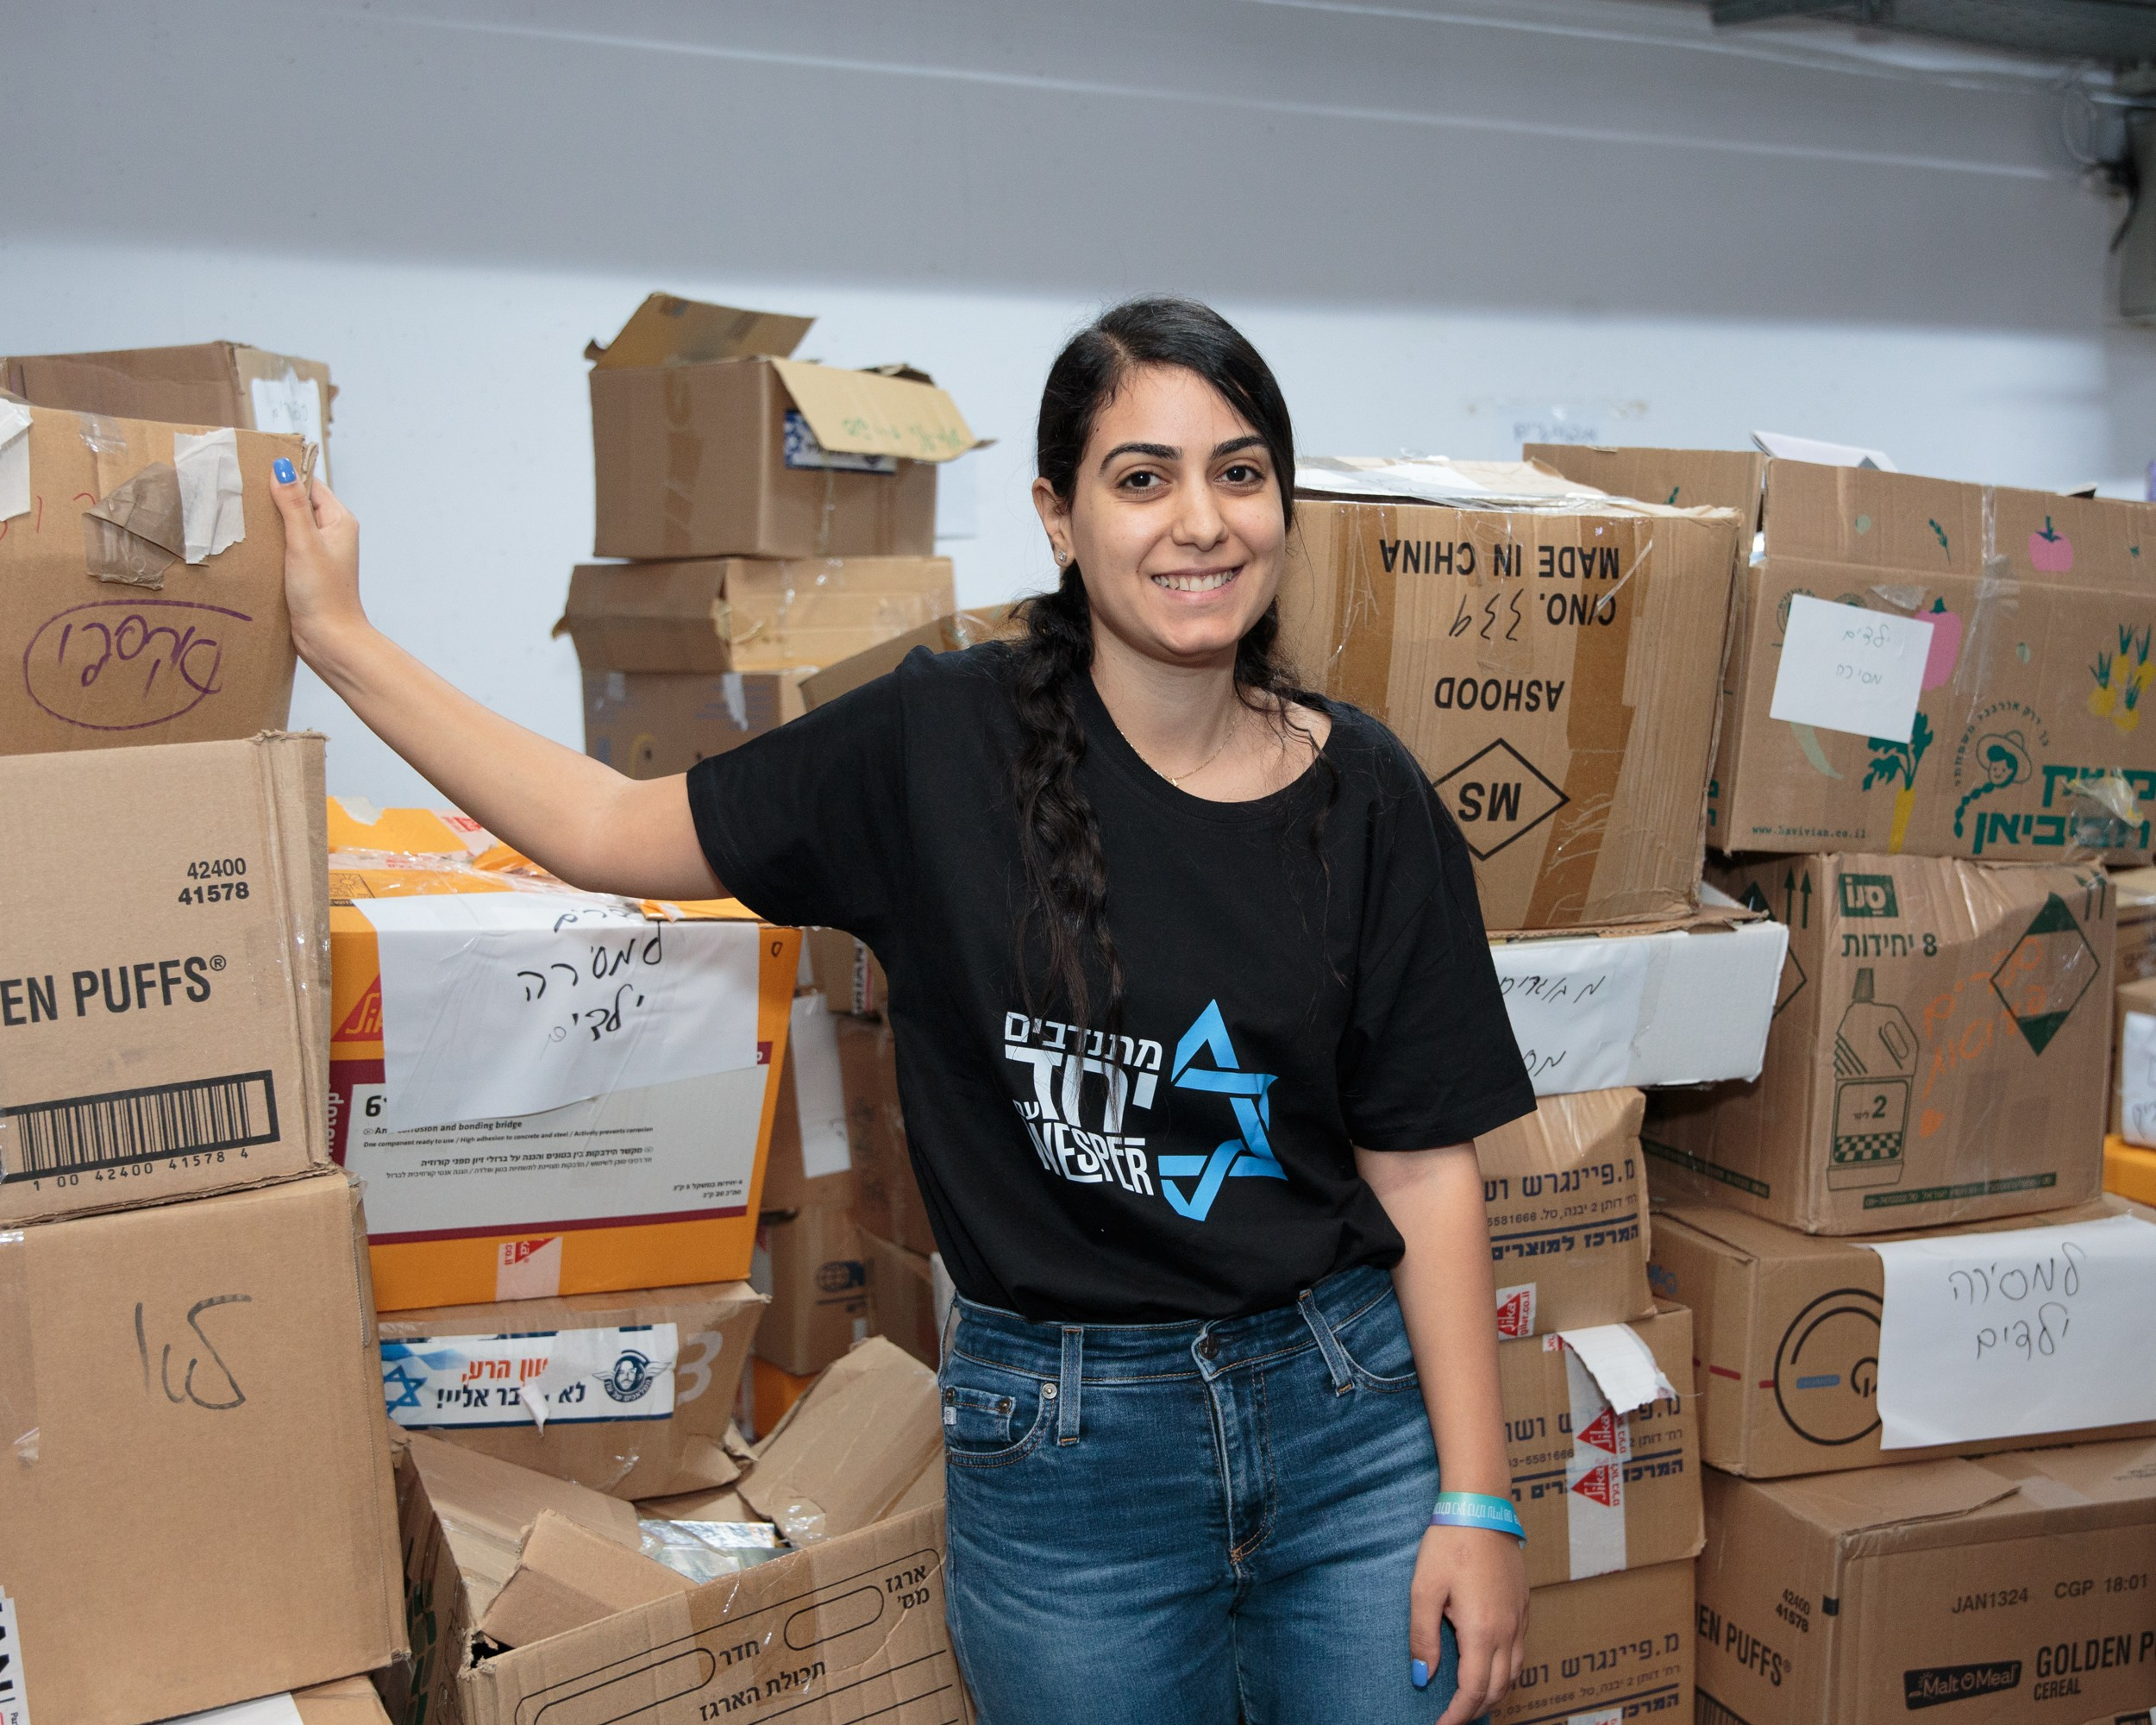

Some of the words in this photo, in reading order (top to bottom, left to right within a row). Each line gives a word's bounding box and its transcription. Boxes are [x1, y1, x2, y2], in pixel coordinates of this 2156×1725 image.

[1379, 538, 1476, 576] CHINA
[1493, 543, 1522, 579] IN
[1538, 545, 1620, 580] MADE
[1539, 593, 1616, 626] C/NO.
[1433, 676, 1565, 712] ASHOOD
[1457, 782, 1522, 822] MS
[186, 857, 247, 880] 42400
[178, 881, 250, 906] 41578
[1841, 933, 1915, 957] יחידות
[1922, 932, 1938, 957] 8
[1005, 1044, 1159, 1133] יחד
[1871, 1095, 1887, 1119] 2
[459, 1122, 493, 1132] bonding
[495, 1120, 522, 1130] bridge
[33, 1179, 41, 1192] 1
[57, 1173, 79, 1188] 00
[95, 1161, 154, 1182] 42400
[169, 1151, 226, 1170] 41578
[240, 1147, 249, 1159] 4
[1583, 1224, 1639, 1249] המרכז
[558, 1380, 586, 1403] לא
[1589, 1414, 1613, 1449] Sika
[886, 1564, 927, 1594] ארגז
[1952, 1586, 2029, 1616] JAN1324
[2054, 1579, 2095, 1599] CGP
[2104, 1573, 2148, 1593] 18:01
[718, 1639, 761, 1666] חדר
[2035, 1634, 2131, 1678] GOLDEN
[766, 1660, 826, 1698] תכולת
[2034, 1678, 2082, 1702] CEREAL
[699, 1685, 761, 1722] הארגז
